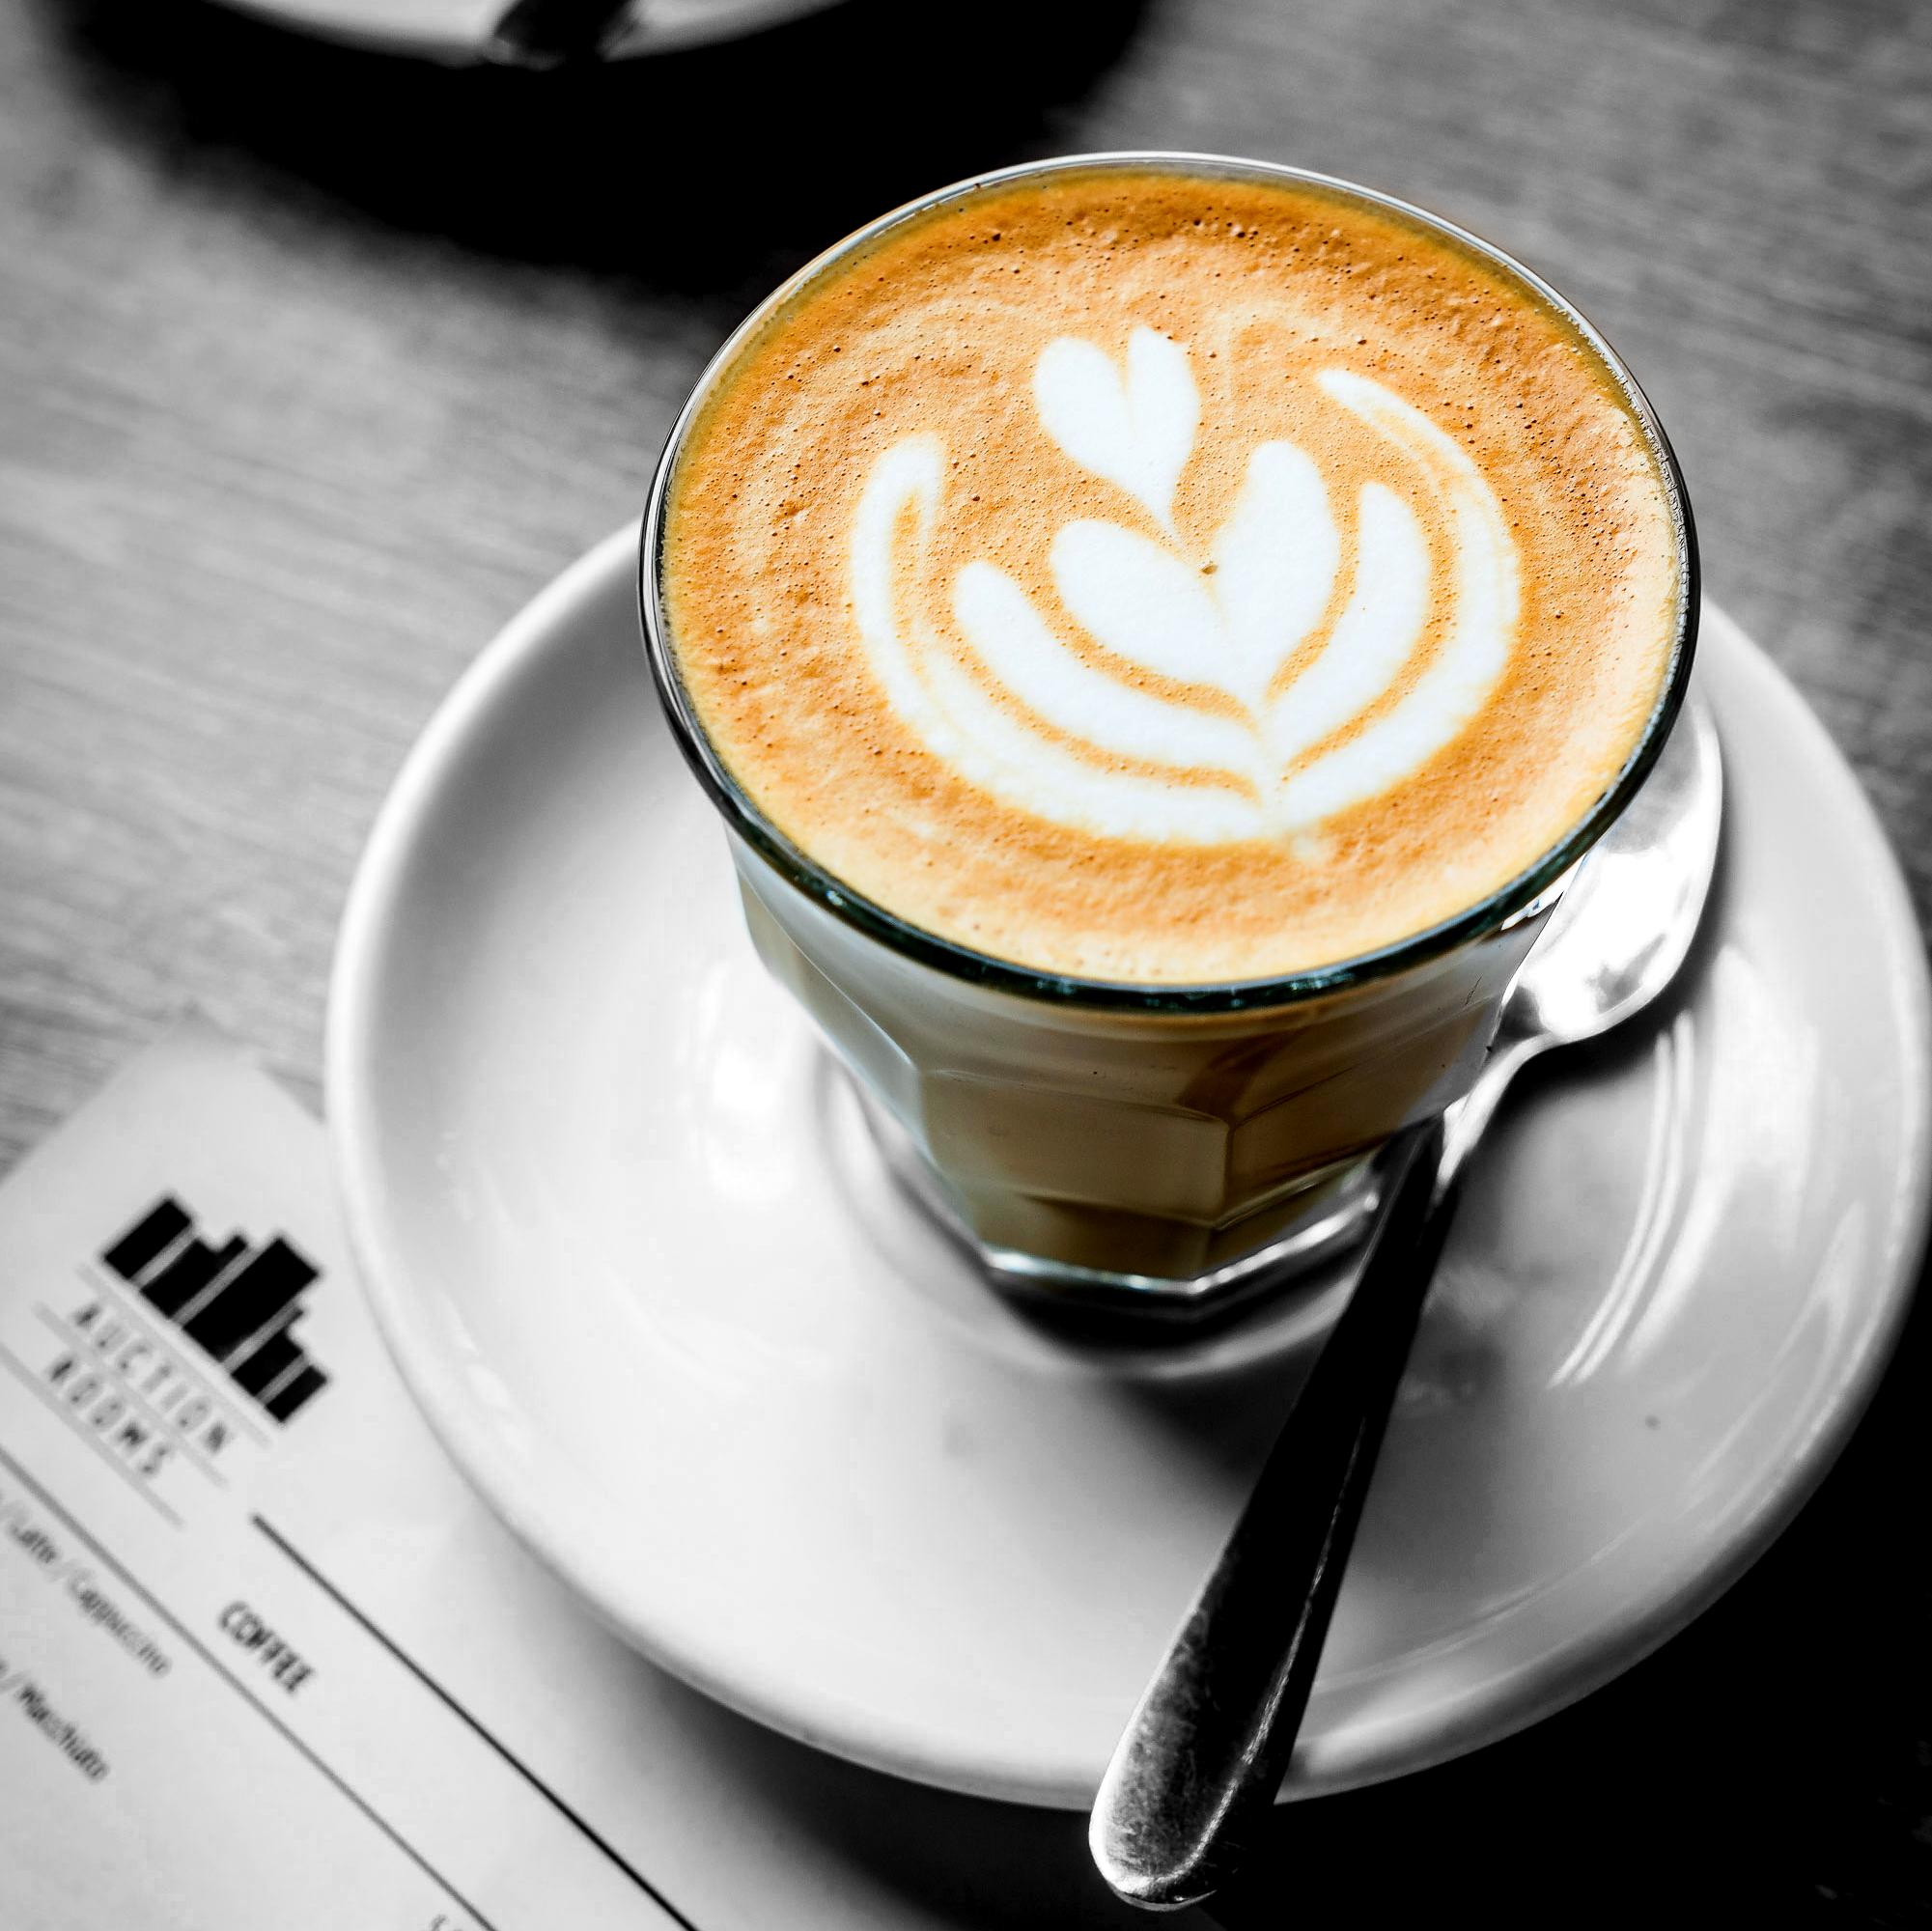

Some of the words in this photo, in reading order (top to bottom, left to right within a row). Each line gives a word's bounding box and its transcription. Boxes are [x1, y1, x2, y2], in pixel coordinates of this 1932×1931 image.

[48, 1352, 176, 1478] ROOMS
[72, 1301, 235, 1455] AUCTION
[217, 1602, 316, 1693] COFFEE
